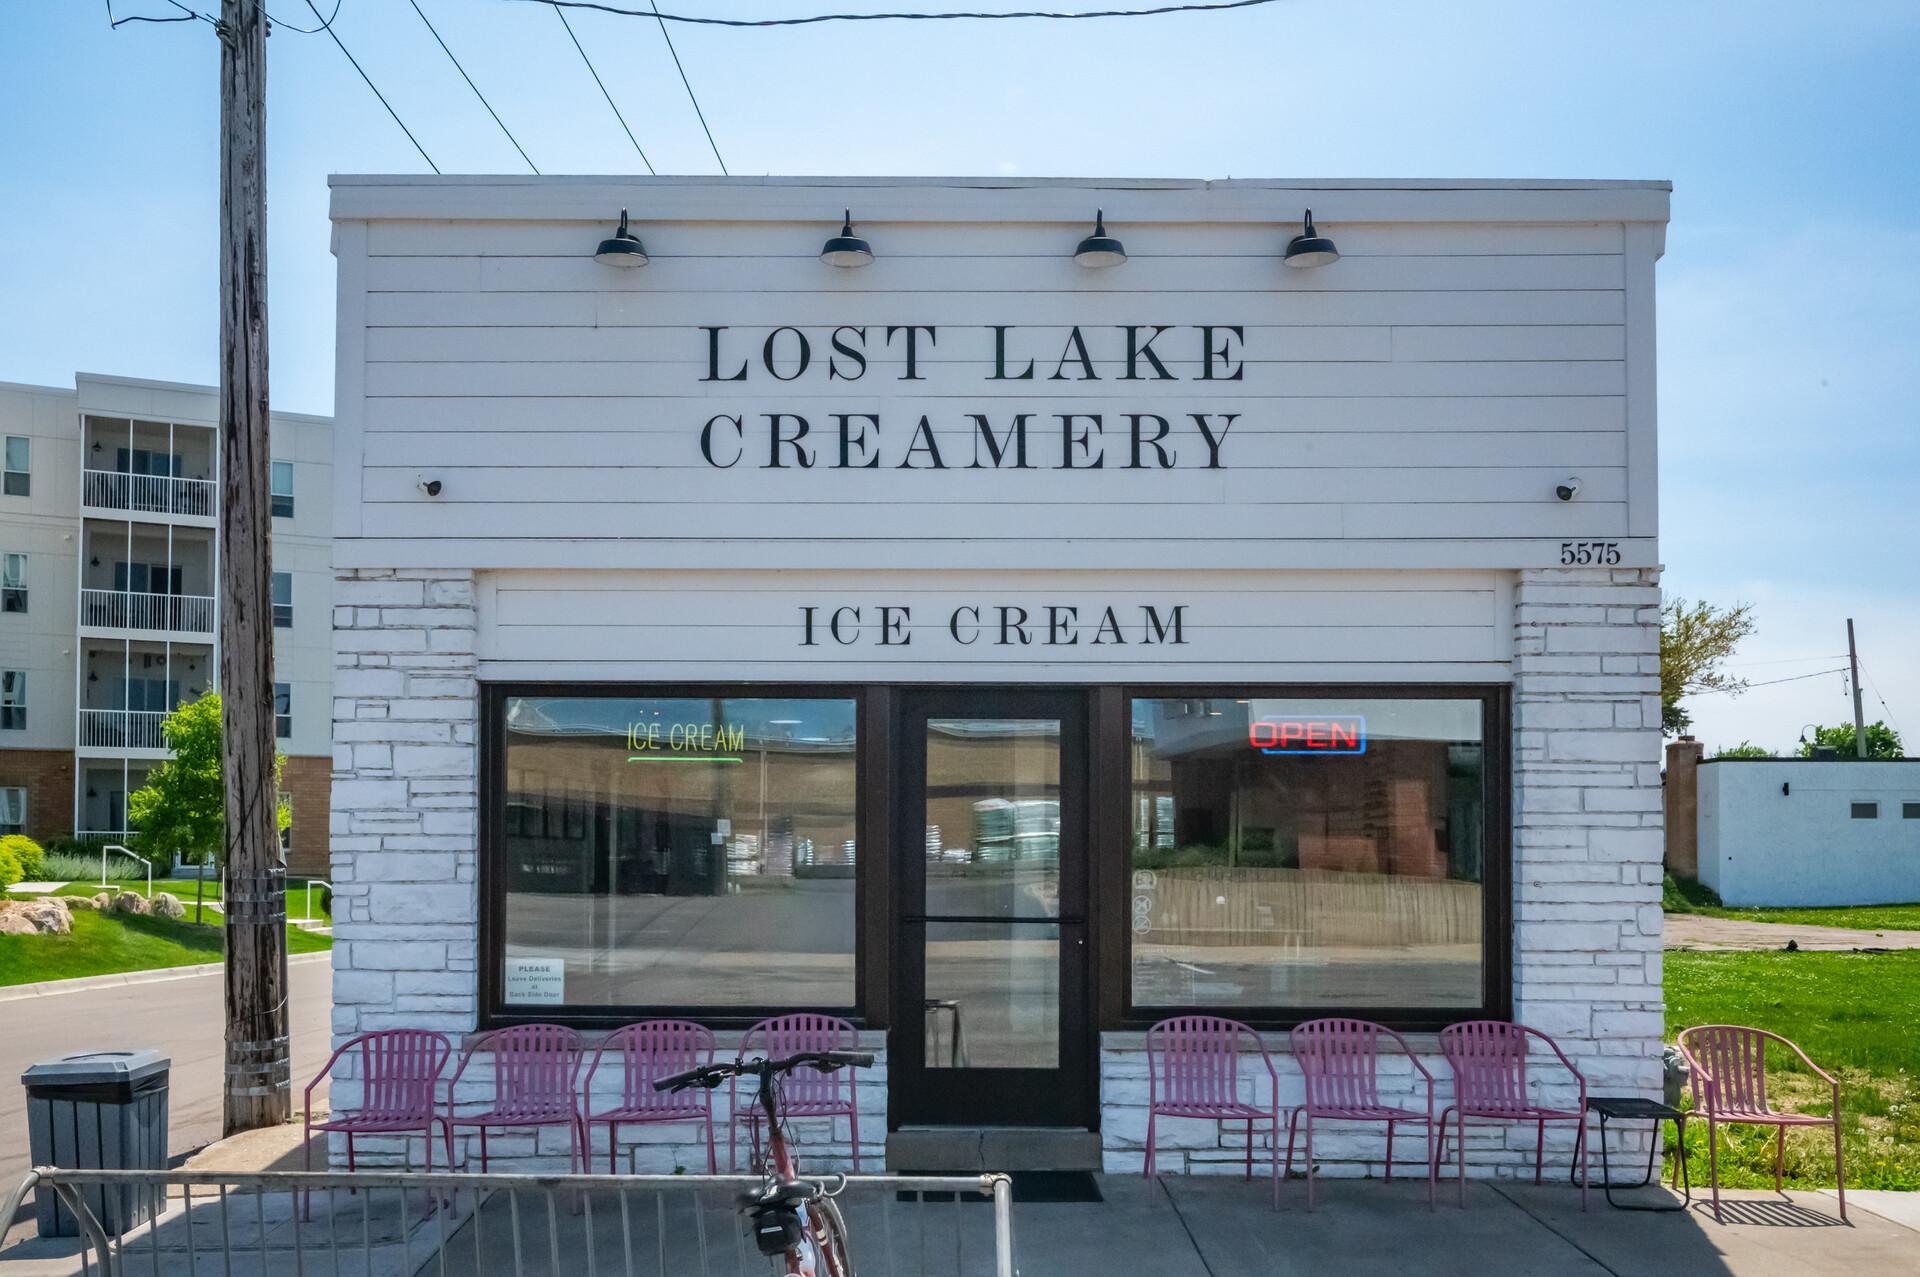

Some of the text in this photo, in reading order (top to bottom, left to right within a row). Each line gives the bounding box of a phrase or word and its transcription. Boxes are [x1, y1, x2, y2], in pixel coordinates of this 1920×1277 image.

[697, 325, 1245, 382] LOST LAKE
[699, 413, 1243, 470] CREAMERY
[1560, 542, 1621, 566] 5575
[797, 605, 1191, 646] ICE CREAM
[627, 721, 744, 752] ICE CREAM
[1249, 721, 1356, 748] OPEN
[518, 965, 551, 973] PLEASE
